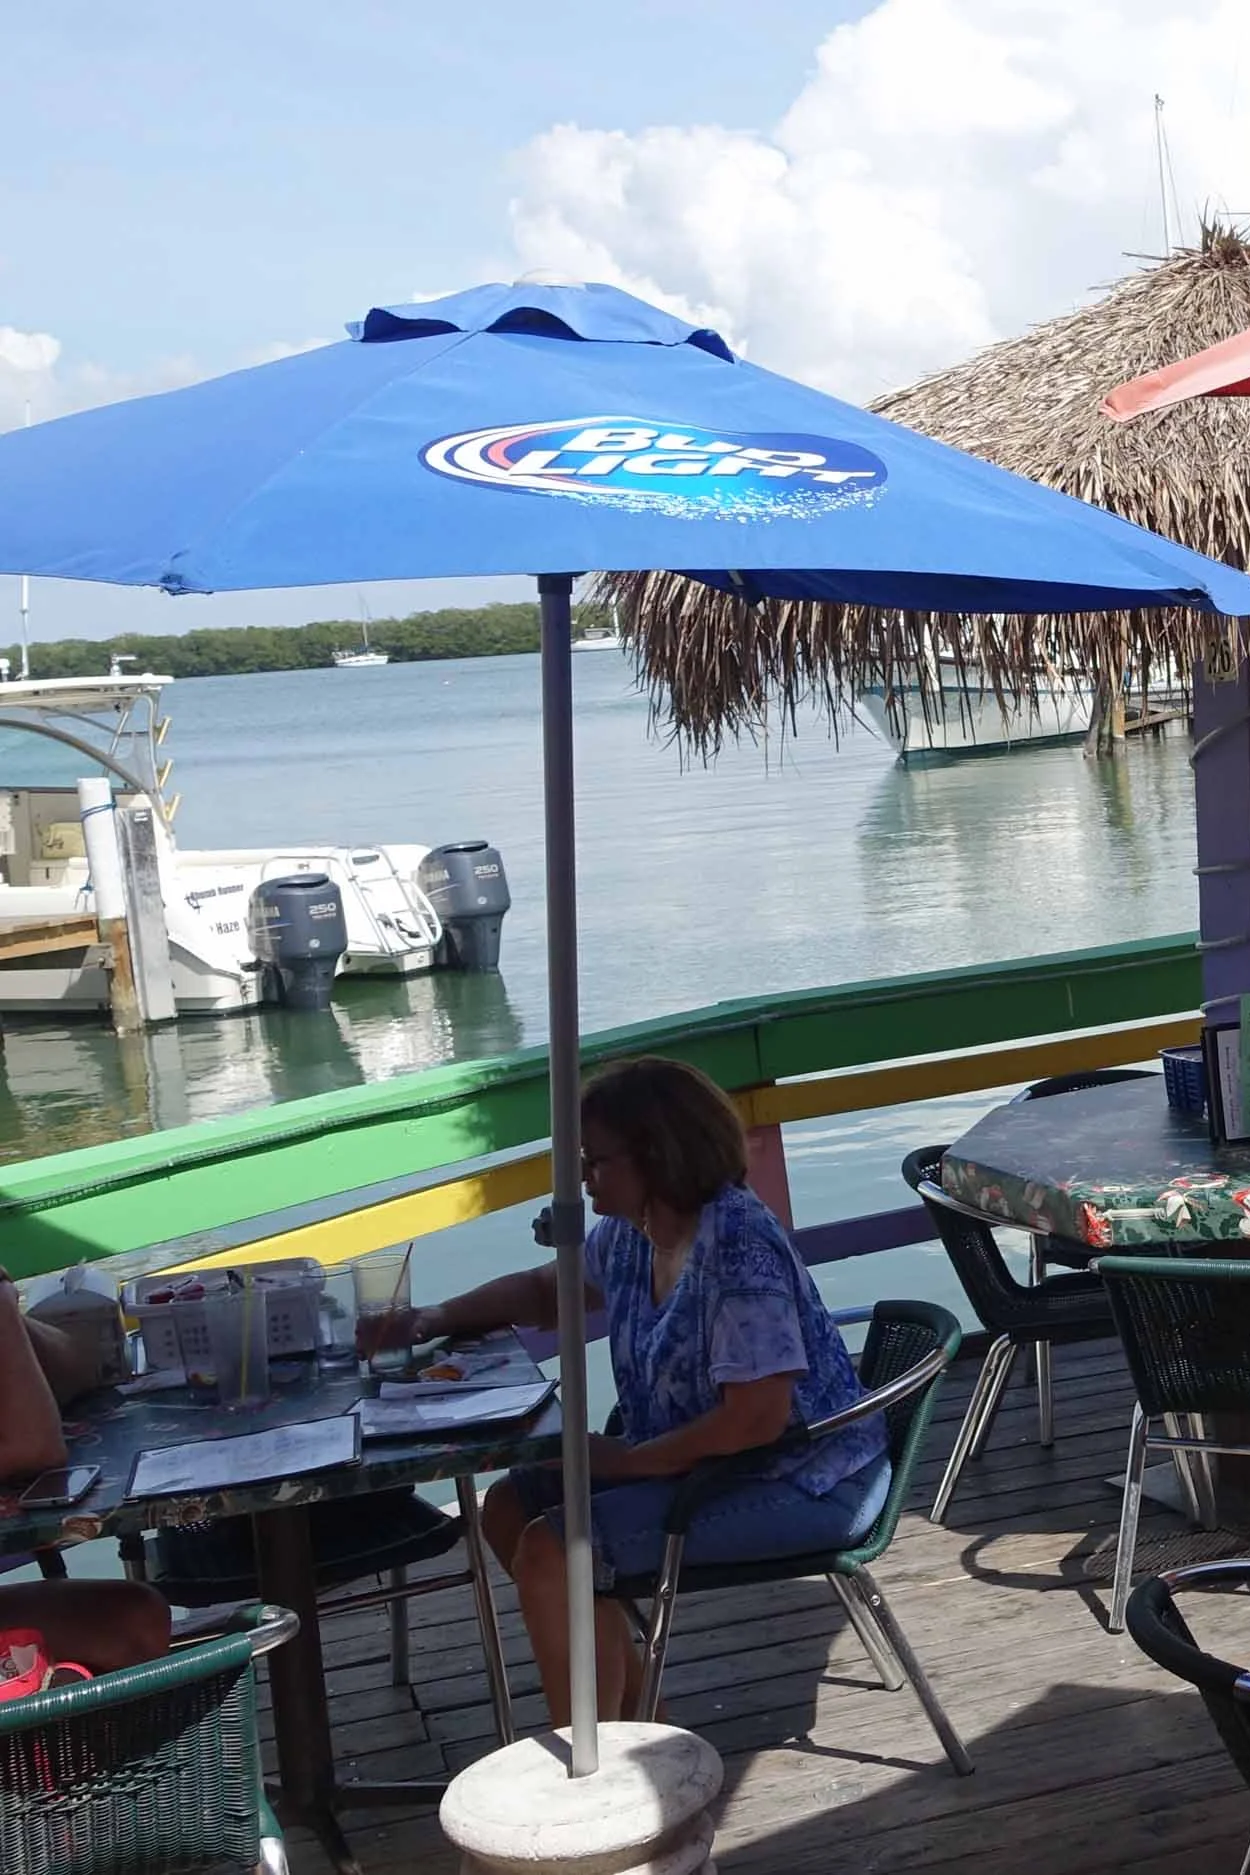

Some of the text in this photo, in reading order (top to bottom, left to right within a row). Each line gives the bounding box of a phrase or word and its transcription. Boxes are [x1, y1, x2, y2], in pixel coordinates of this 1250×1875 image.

[507, 450, 876, 484] LIGHT
[473, 864, 499, 875] 250
[308, 902, 337, 915] 250
